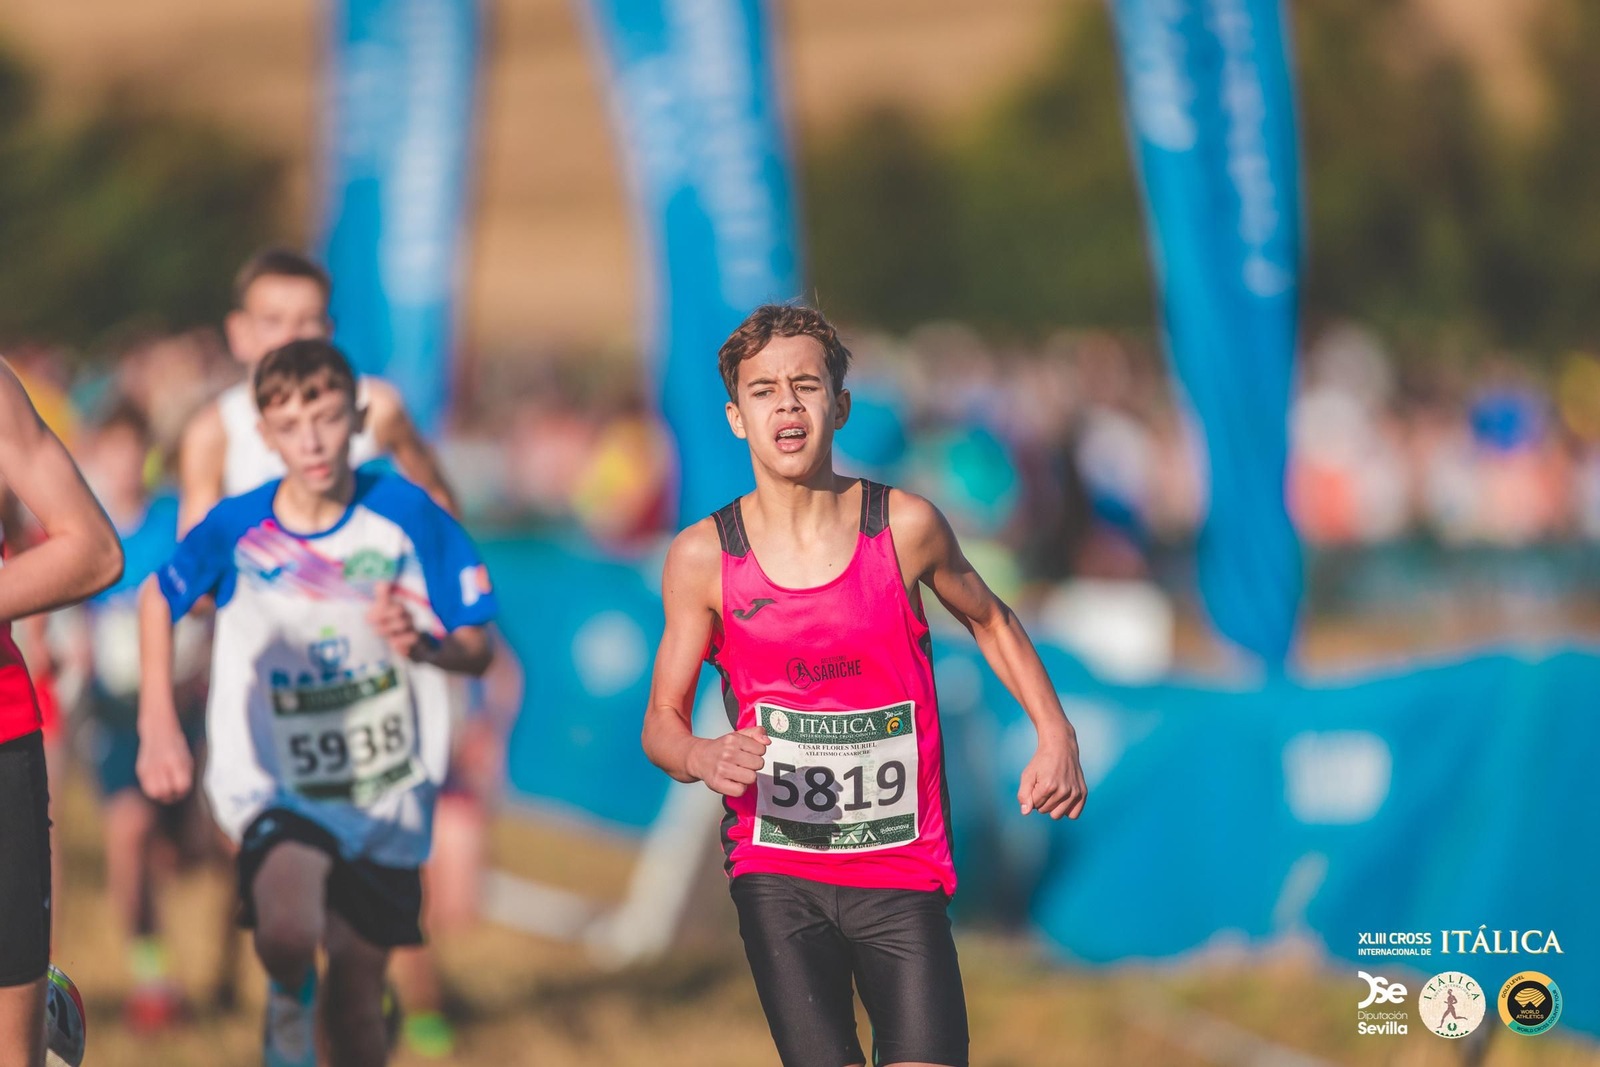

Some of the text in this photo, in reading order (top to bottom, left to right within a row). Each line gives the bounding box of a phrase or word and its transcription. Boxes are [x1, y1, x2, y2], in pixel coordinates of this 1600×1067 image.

[799, 716, 877, 734] ITÁLICA
[289, 714, 405, 776] 5938
[838, 749, 871, 757] CASARICHE
[851, 742, 877, 750] MURIEL
[772, 760, 906, 812] 5819
